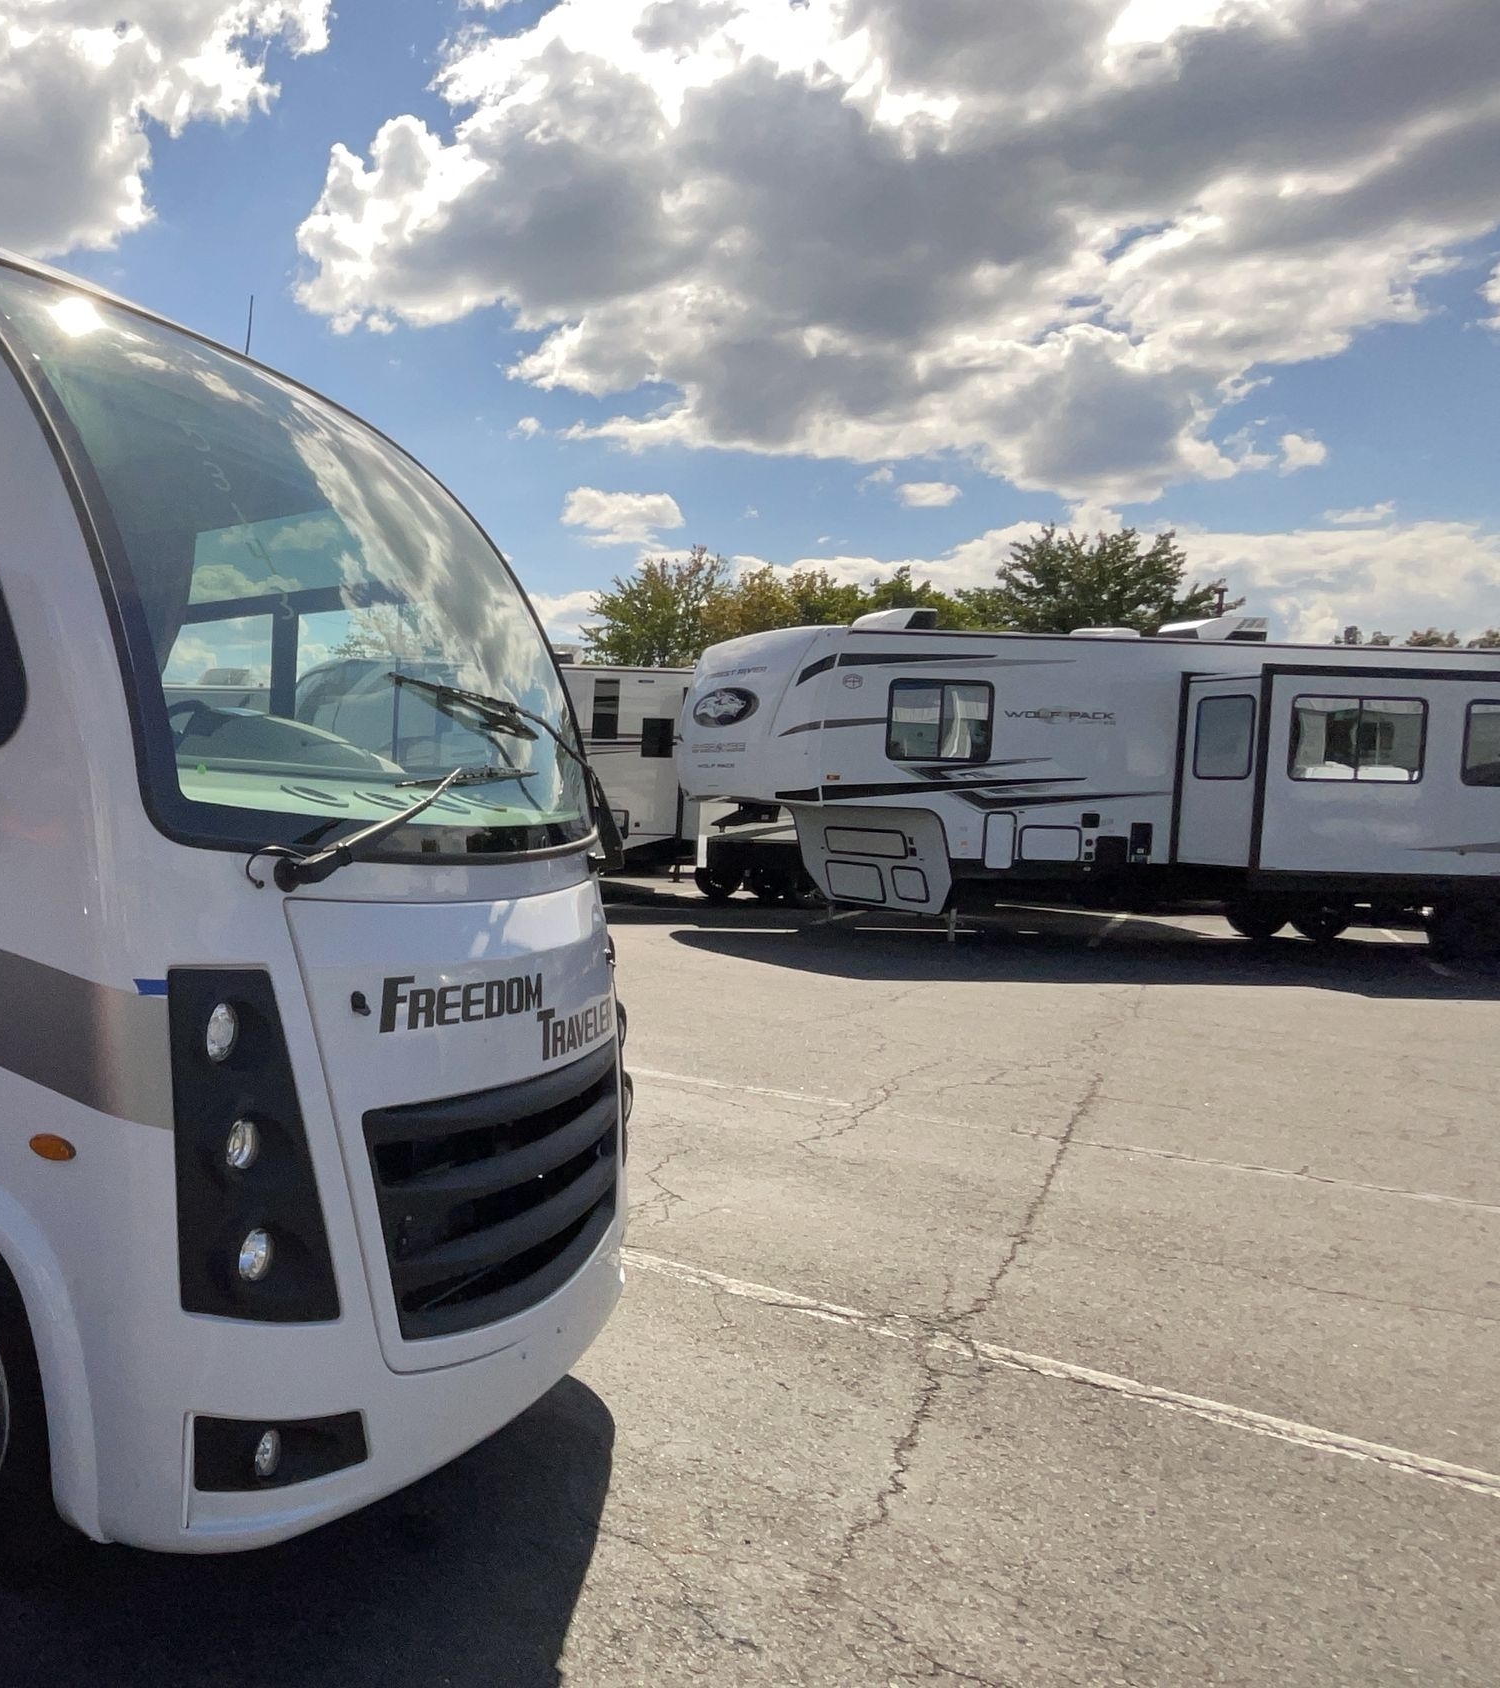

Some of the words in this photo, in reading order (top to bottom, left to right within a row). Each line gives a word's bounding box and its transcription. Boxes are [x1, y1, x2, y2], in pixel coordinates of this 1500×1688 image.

[1004, 710, 1062, 720] WOLF
[1069, 711, 1116, 721] PACK
[379, 972, 543, 1034] FREEDOM
[537, 995, 614, 1061] TRAVELER
